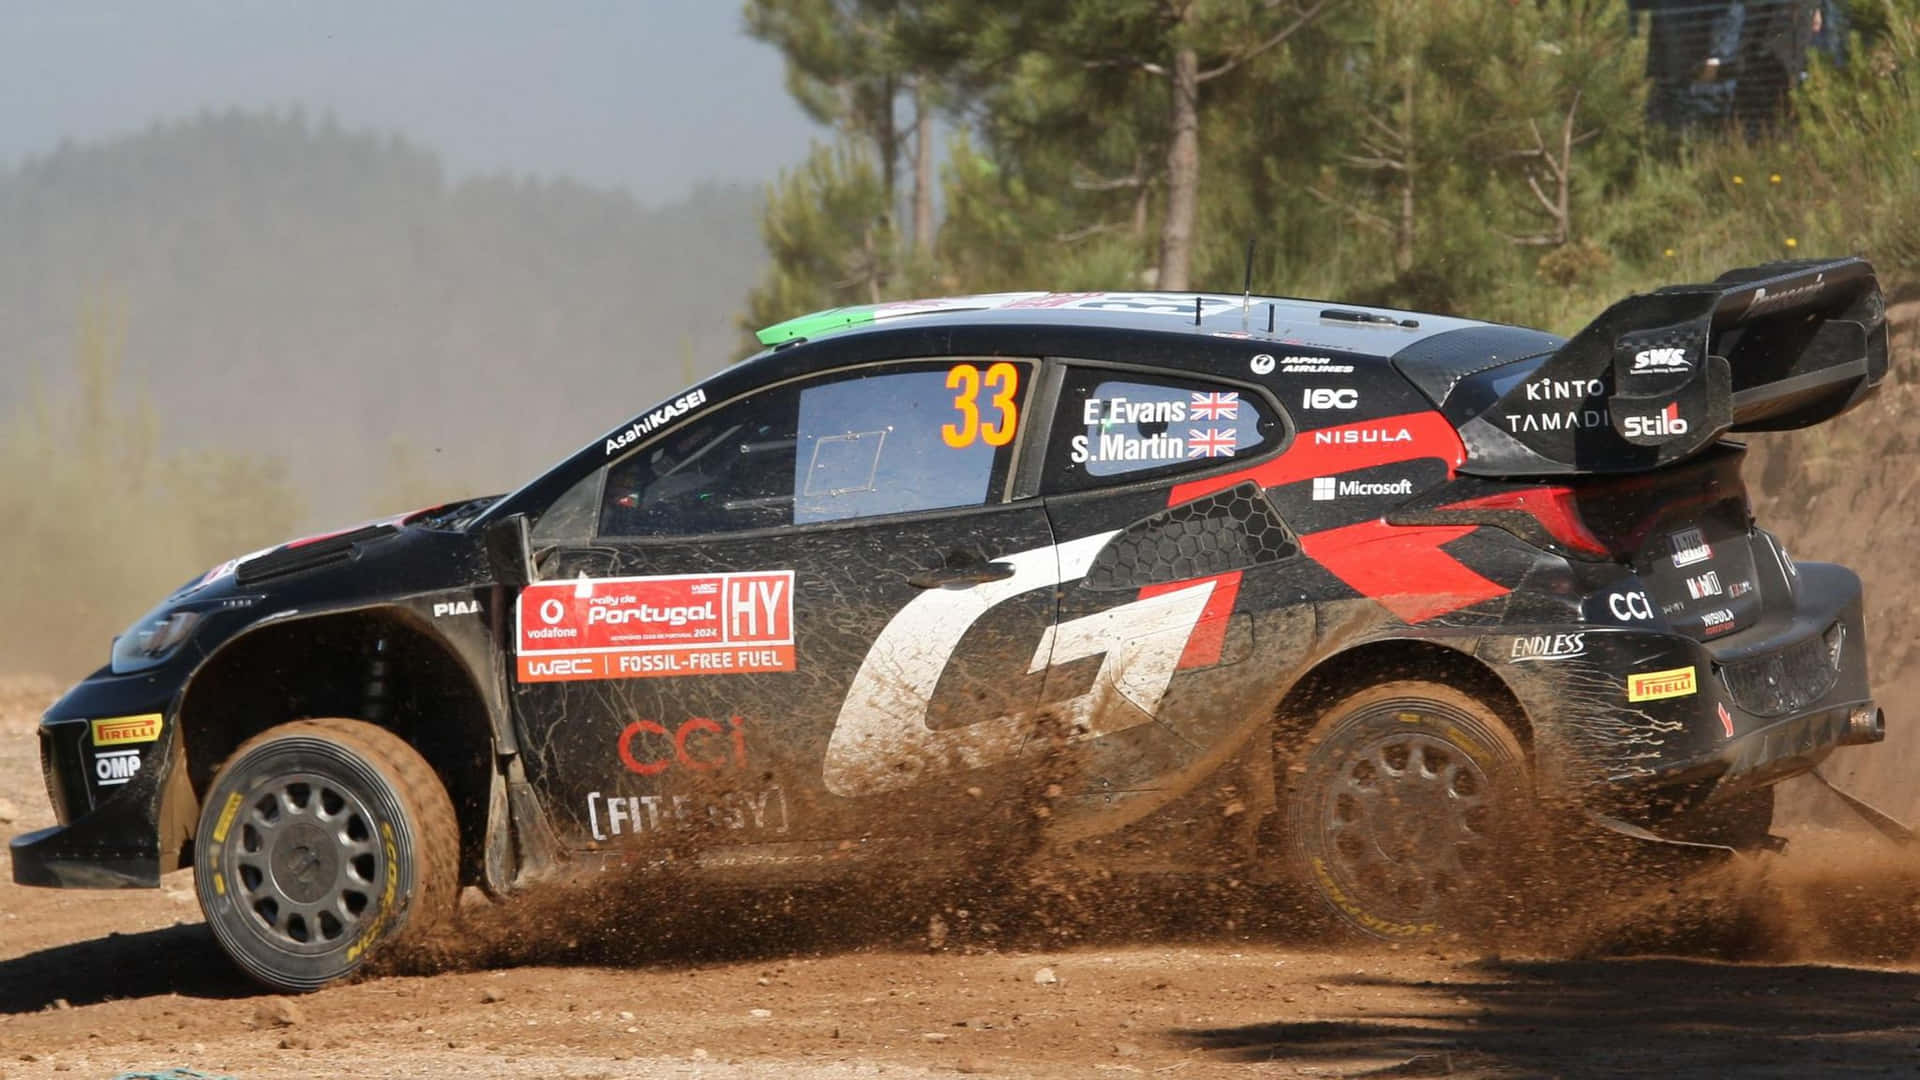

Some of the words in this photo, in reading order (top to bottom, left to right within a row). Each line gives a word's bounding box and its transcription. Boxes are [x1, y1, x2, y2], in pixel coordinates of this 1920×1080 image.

[1282, 365, 1354, 373] AIRLINES
[941, 362, 1019, 449] 33
[1624, 402, 1688, 437] Stilo
[1315, 428, 1412, 445] NISULA
[1339, 478, 1412, 496] Microsoft
[433, 600, 484, 617] PIAA
[589, 595, 619, 606] rally
[620, 595, 636, 604] de
[732, 581, 784, 636] HY
[588, 601, 717, 626] Portugal
[528, 627, 577, 639] vodafone
[1512, 633, 1585, 657] ENDLESS
[529, 658, 593, 676] WRC
[620, 652, 733, 673] FOSSIL-FREE
[738, 651, 783, 667] FUEL
[1636, 673, 1691, 697] PIRELLI
[97, 720, 155, 741] PIRELLI
[96, 756, 141, 779] OMP
